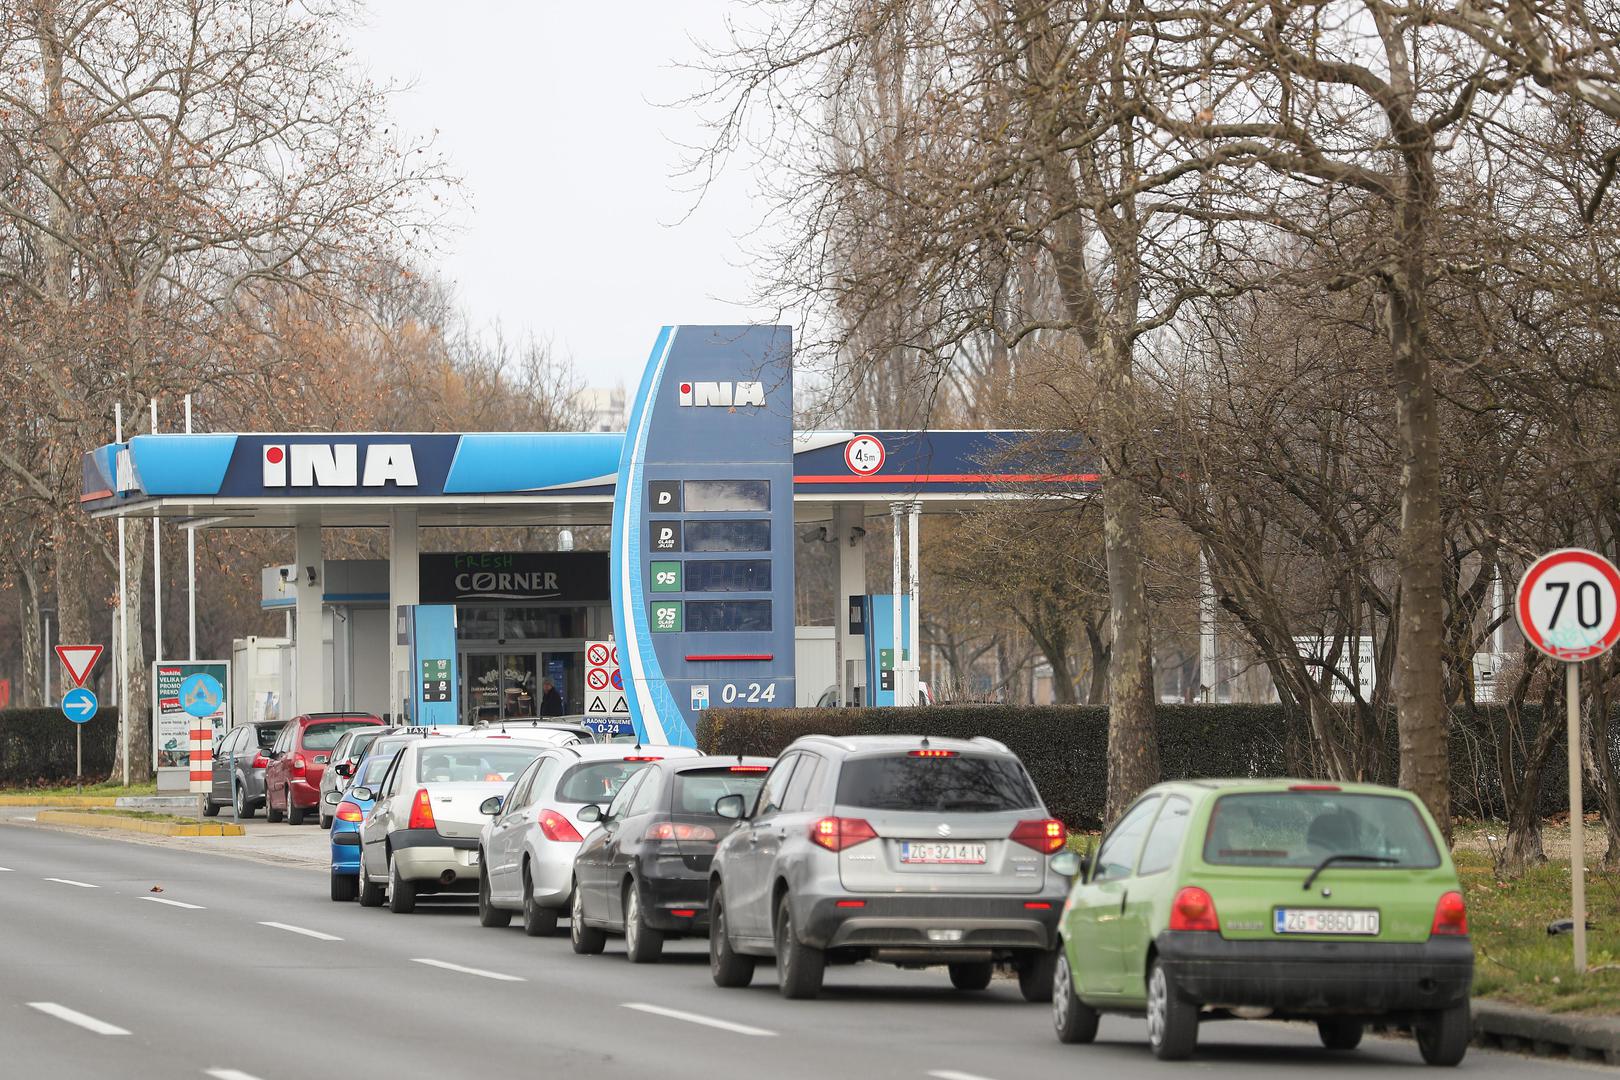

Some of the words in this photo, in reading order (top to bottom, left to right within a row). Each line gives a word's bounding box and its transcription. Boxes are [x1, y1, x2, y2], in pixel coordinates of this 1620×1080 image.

[658, 491, 672, 505] D
[660, 527, 673, 540] D
[454, 572, 559, 591] CORNER
[656, 571, 676, 585] 95
[1546, 581, 1602, 630] 70
[656, 608, 677, 620] 95
[722, 683, 776, 704] 0-24
[597, 725, 620, 733] 0-24
[911, 845, 927, 859] ZG
[1287, 912, 1306, 930] ZG
